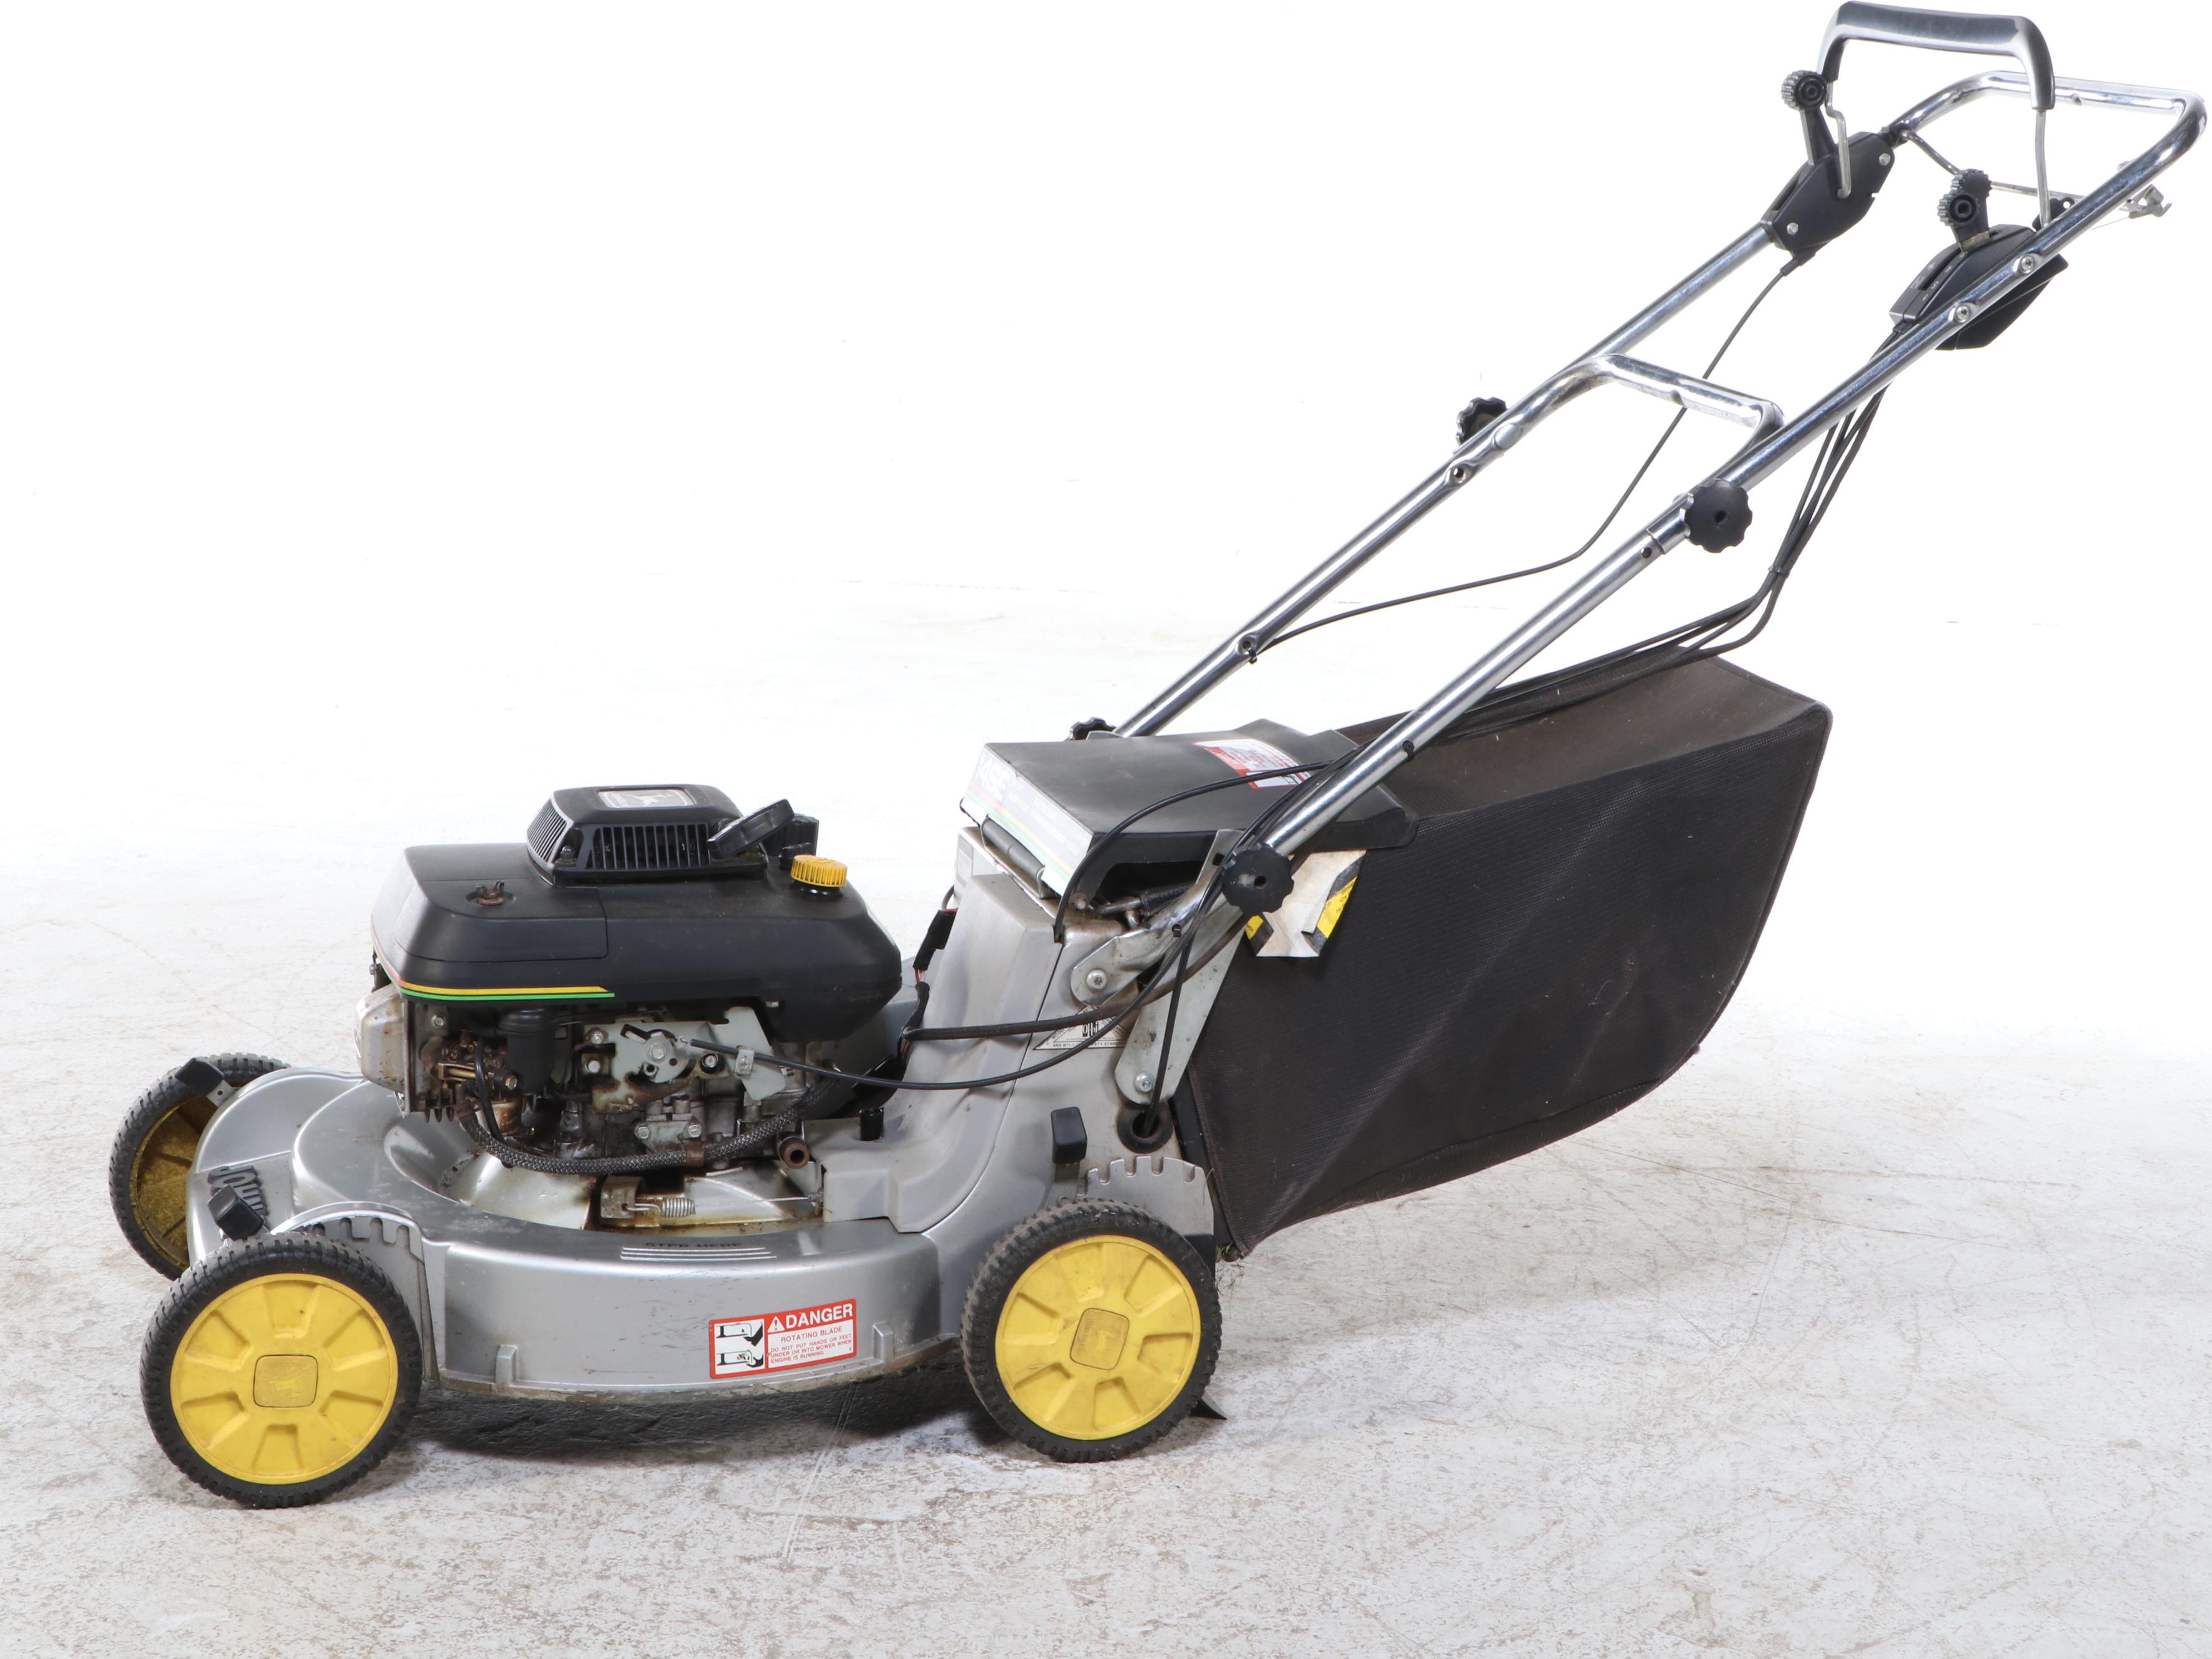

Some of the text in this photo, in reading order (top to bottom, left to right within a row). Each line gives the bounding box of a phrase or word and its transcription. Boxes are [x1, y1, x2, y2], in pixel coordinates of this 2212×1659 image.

[785, 1303, 853, 1329] DANGER
[781, 1326, 843, 1343] ROTATING BLADE
